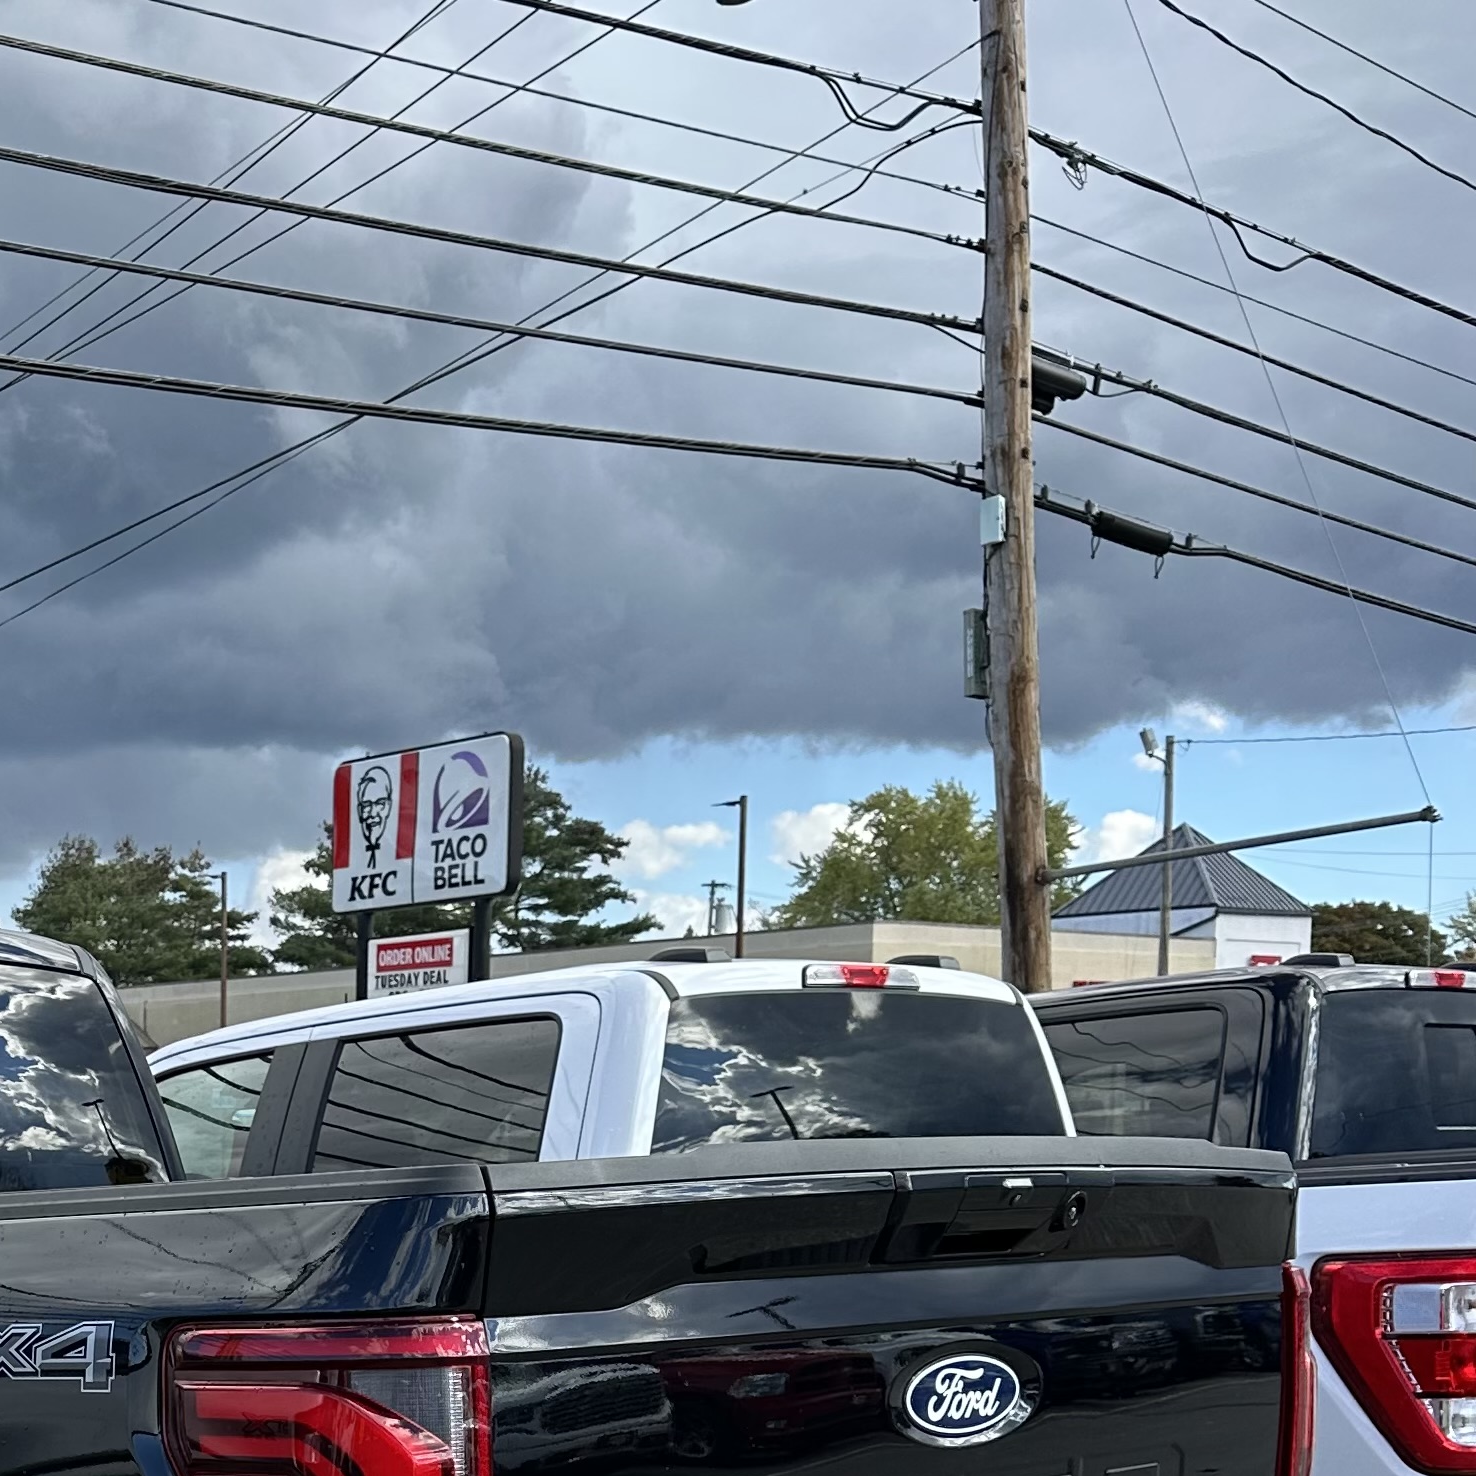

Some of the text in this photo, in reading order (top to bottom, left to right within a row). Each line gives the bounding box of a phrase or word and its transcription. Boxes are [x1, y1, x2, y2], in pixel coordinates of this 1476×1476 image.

[431, 833, 487, 863] TACO
[348, 870, 398, 902] KFC
[434, 861, 485, 890] BELL
[378, 944, 452, 967] ORDER ONLINE
[374, 969, 449, 990] TUESDAY DEAL
[927, 1367, 1002, 1422] Ford
